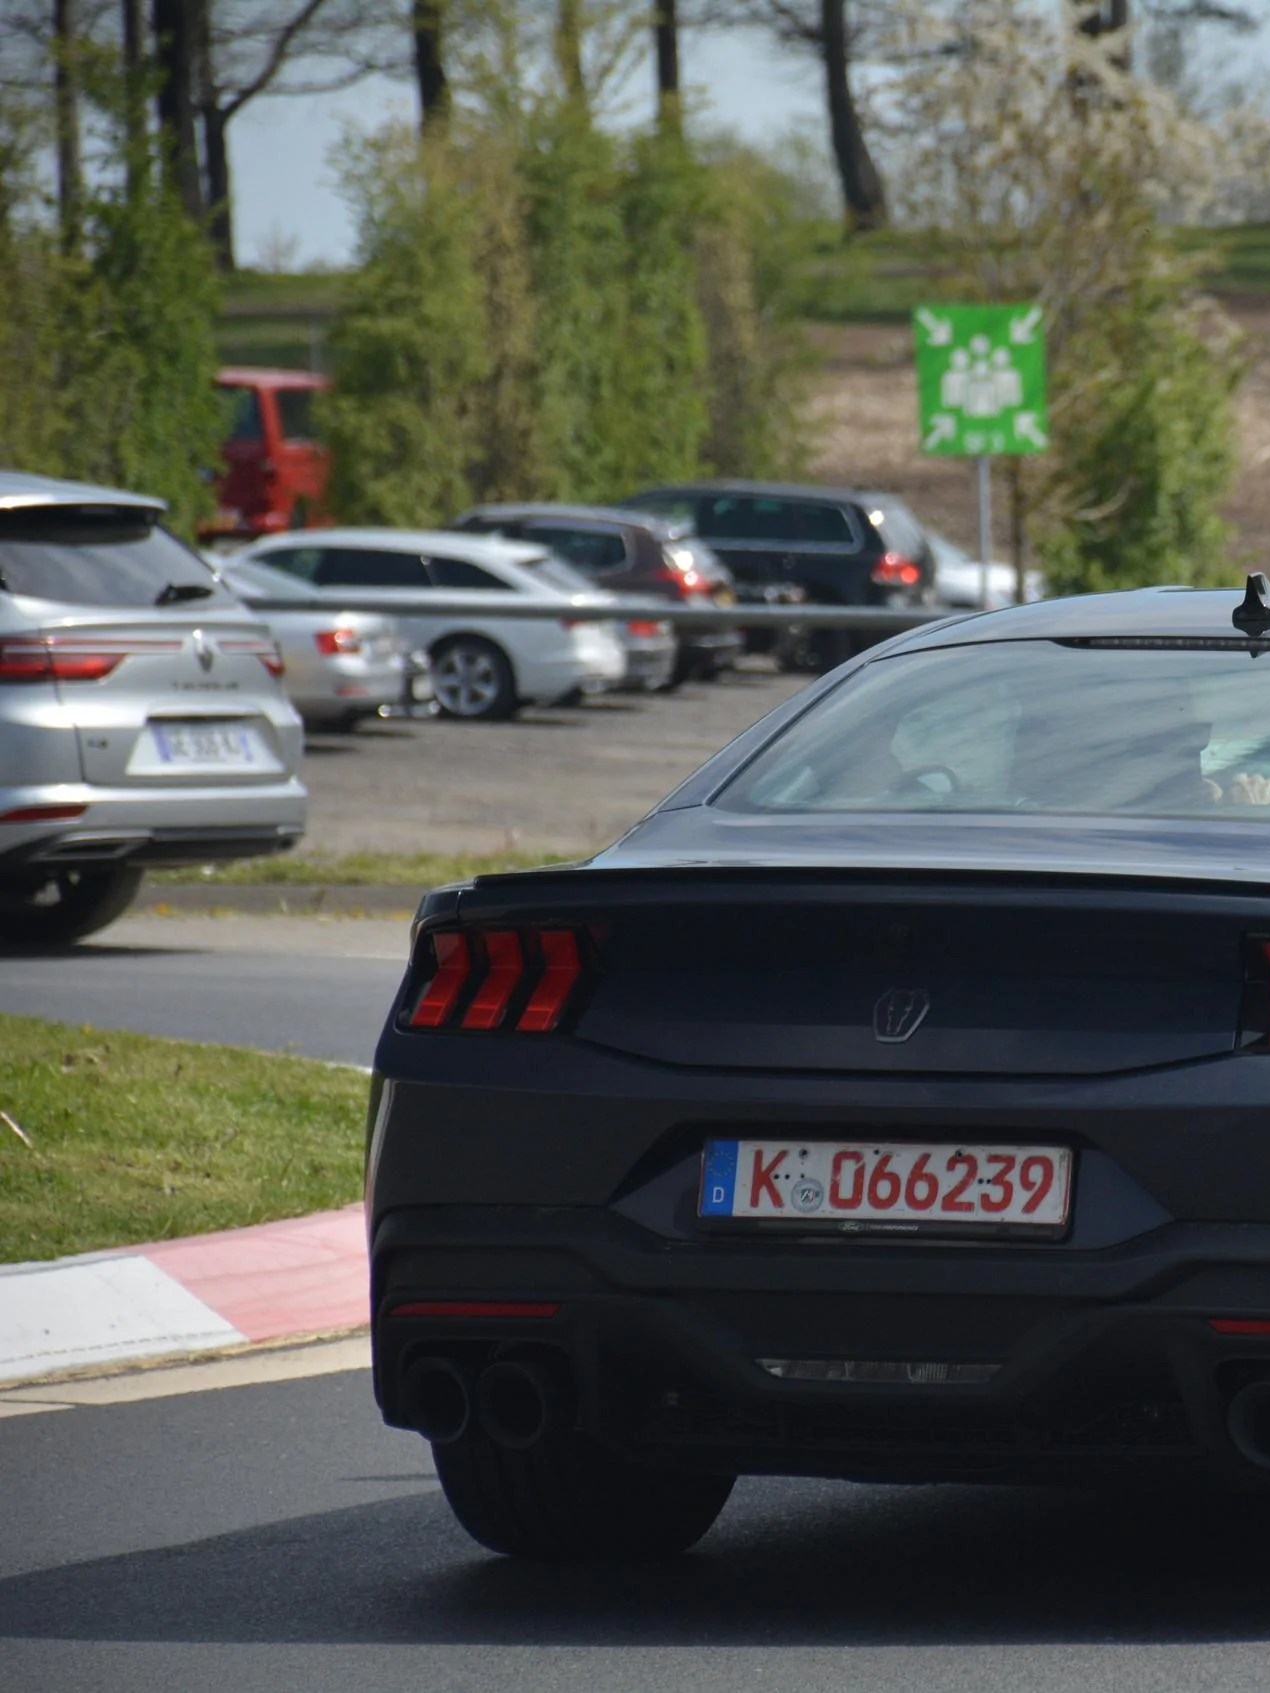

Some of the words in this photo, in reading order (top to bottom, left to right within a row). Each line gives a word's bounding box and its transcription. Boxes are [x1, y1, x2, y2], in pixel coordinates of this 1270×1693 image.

[712, 1187, 724, 1203] D
[750, 1148, 789, 1208] K
[828, 1150, 1055, 1214] 066239
